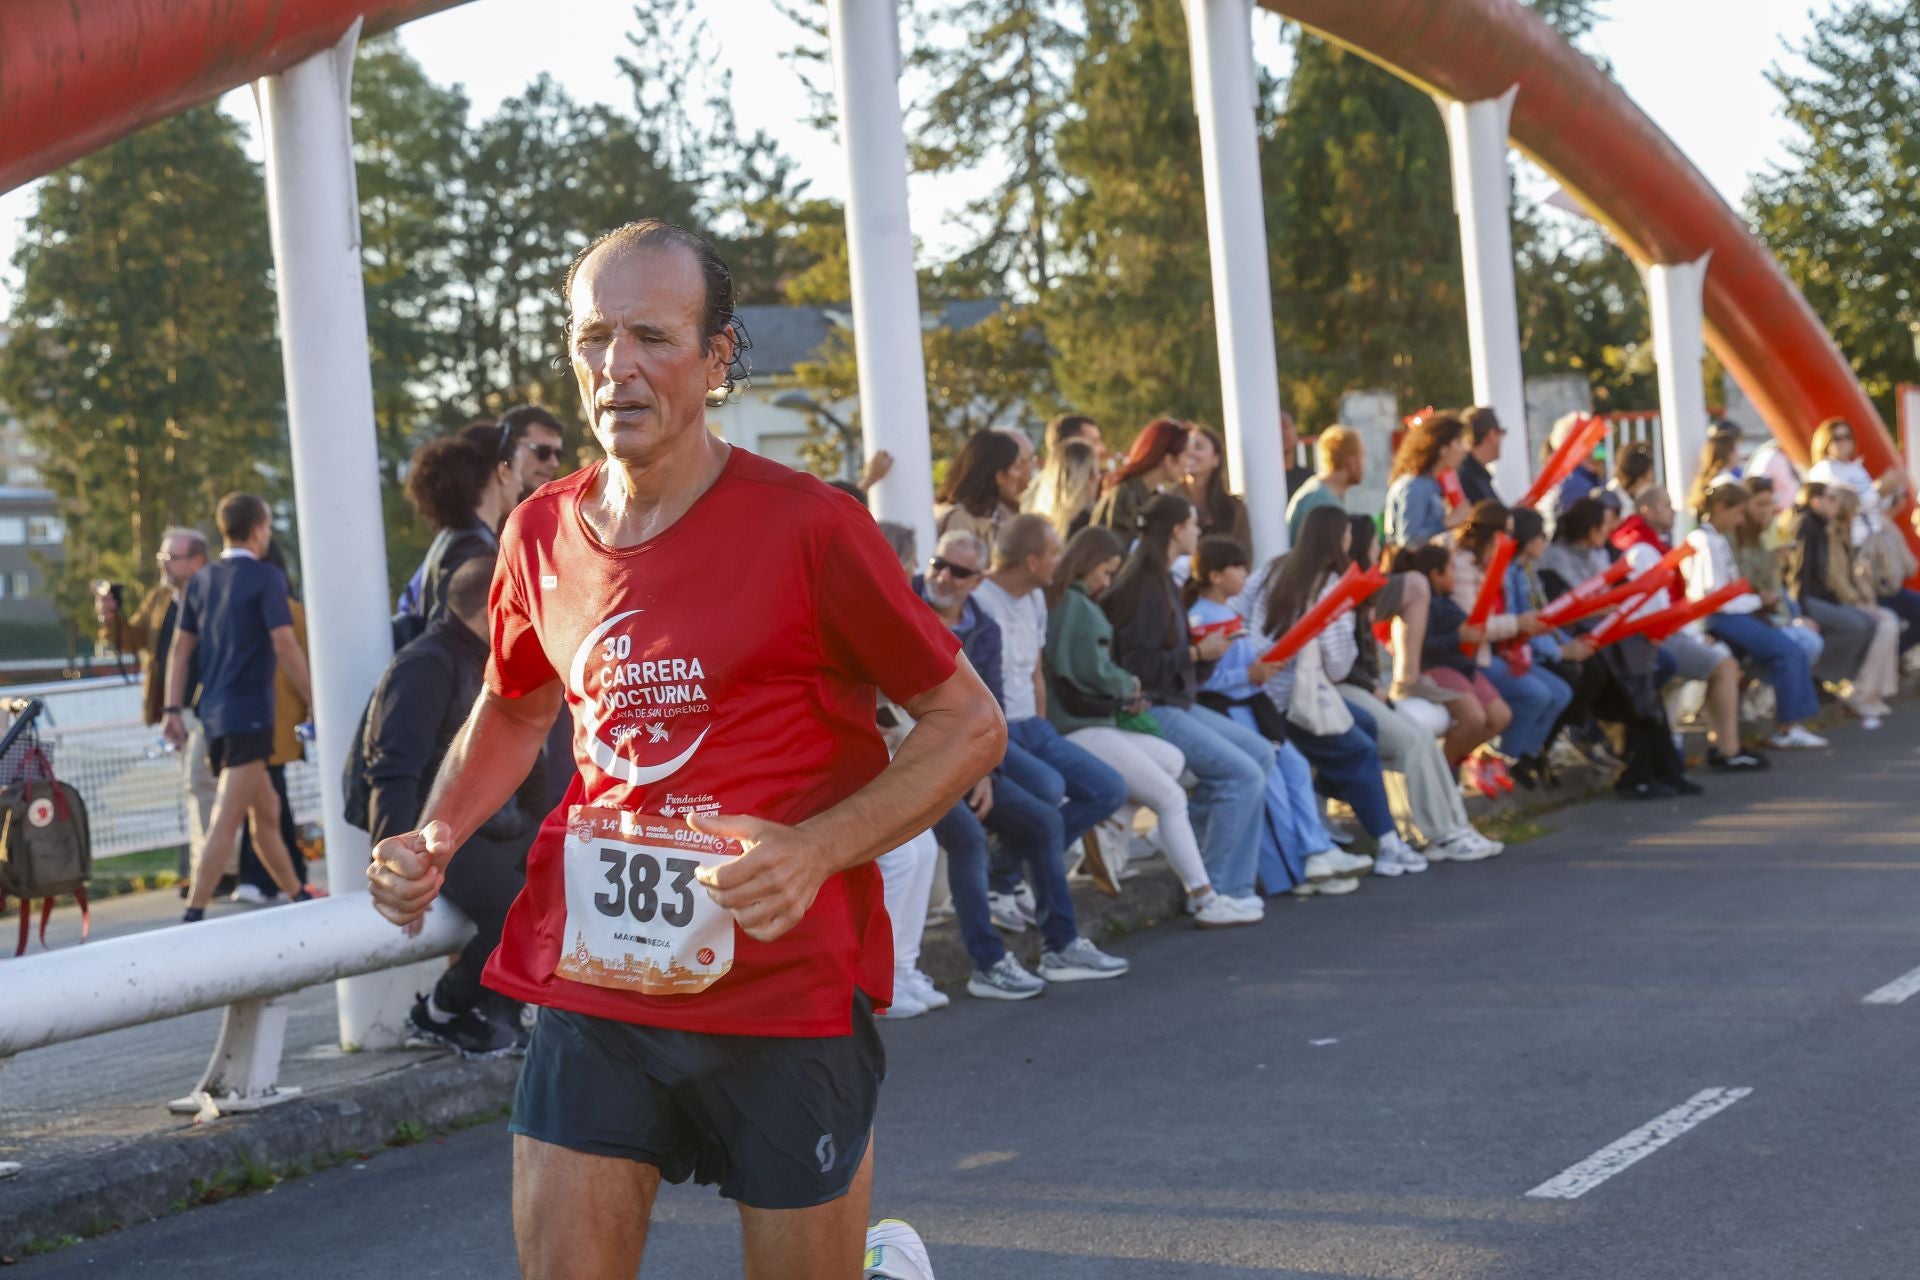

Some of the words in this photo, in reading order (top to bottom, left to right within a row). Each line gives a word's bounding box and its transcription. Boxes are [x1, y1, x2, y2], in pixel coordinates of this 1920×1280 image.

[602, 634, 631, 662] 30
[599, 657, 706, 689] CARRERA
[601, 684, 708, 711] NOCTURNA
[635, 708, 647, 718] DE
[646, 708, 662, 718] SAN
[663, 703, 710, 719] LORENZO
[665, 793, 714, 805] Fundación
[594, 847, 701, 928] 383
